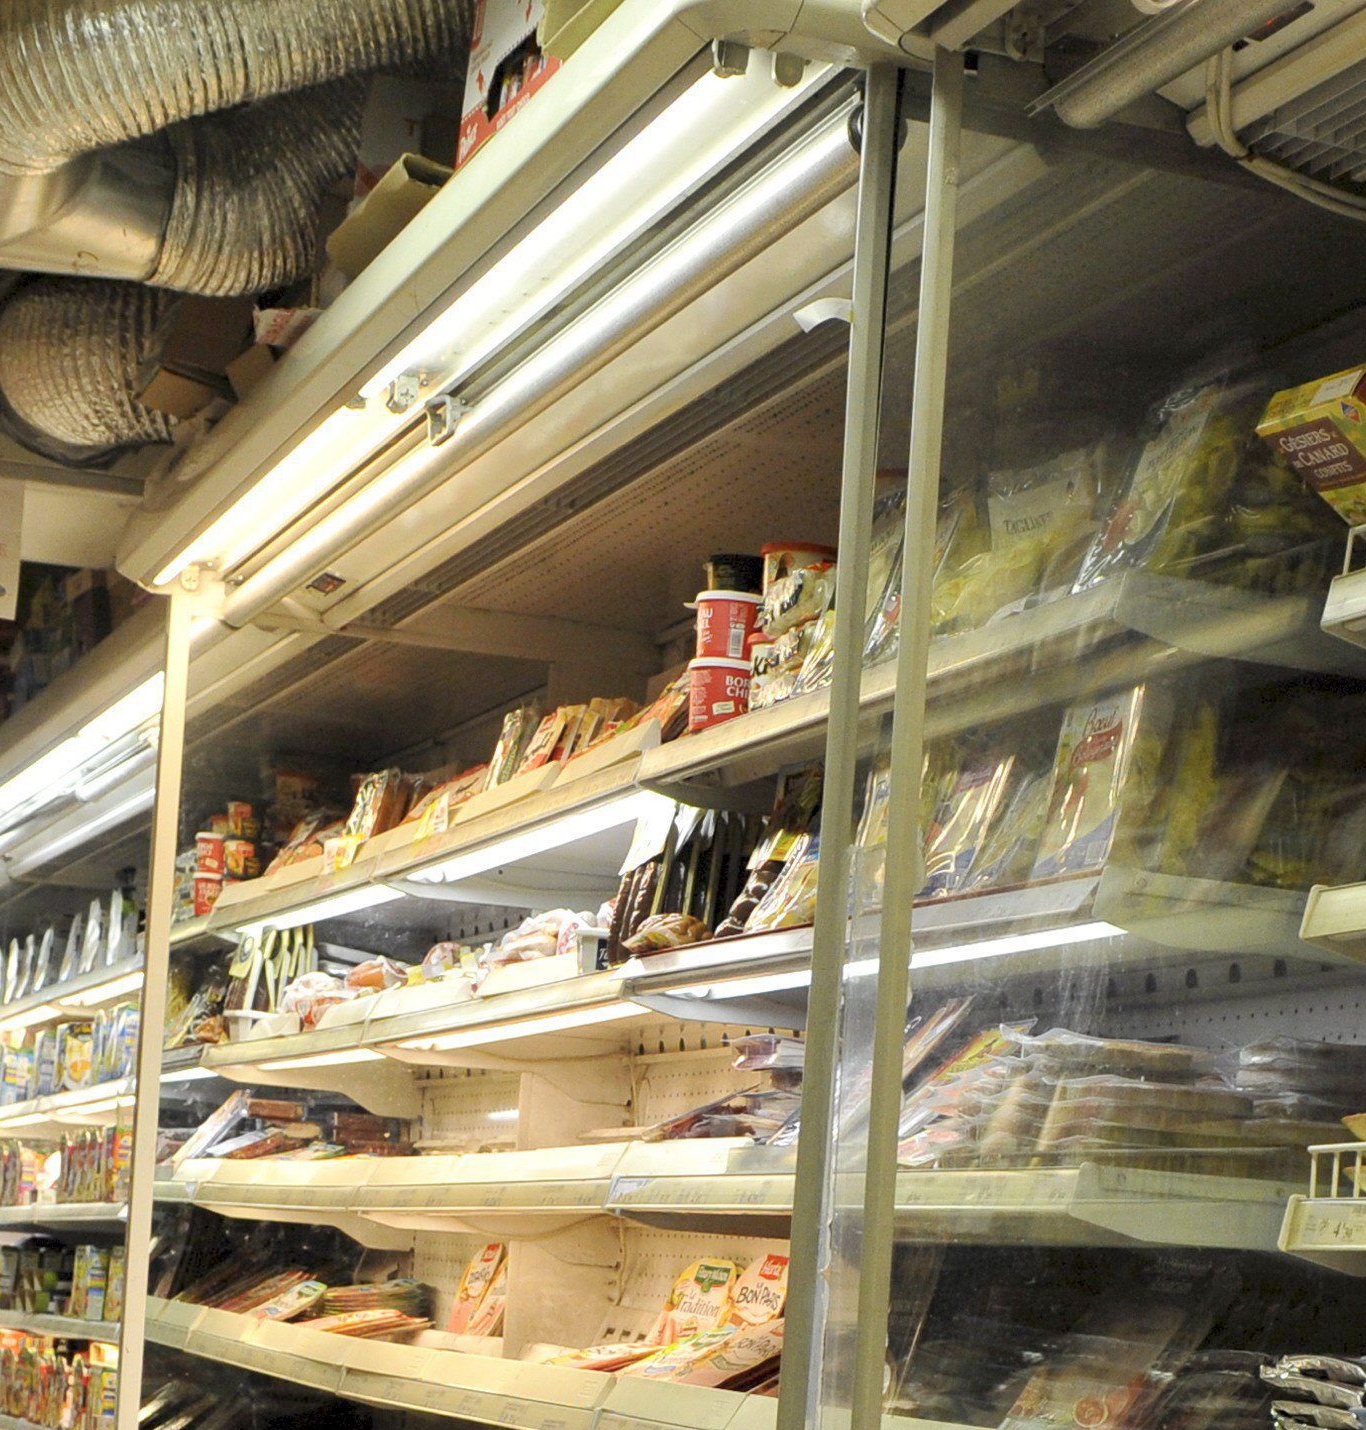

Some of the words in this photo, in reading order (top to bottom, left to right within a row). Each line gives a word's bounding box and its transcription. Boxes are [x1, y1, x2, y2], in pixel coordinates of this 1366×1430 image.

[1279, 428, 1331, 454] GÉSIERS
[1298, 442, 1349, 468] CANARD
[1313, 460, 1354, 481] CONFITS
[675, 1293, 722, 1319] Tradition
